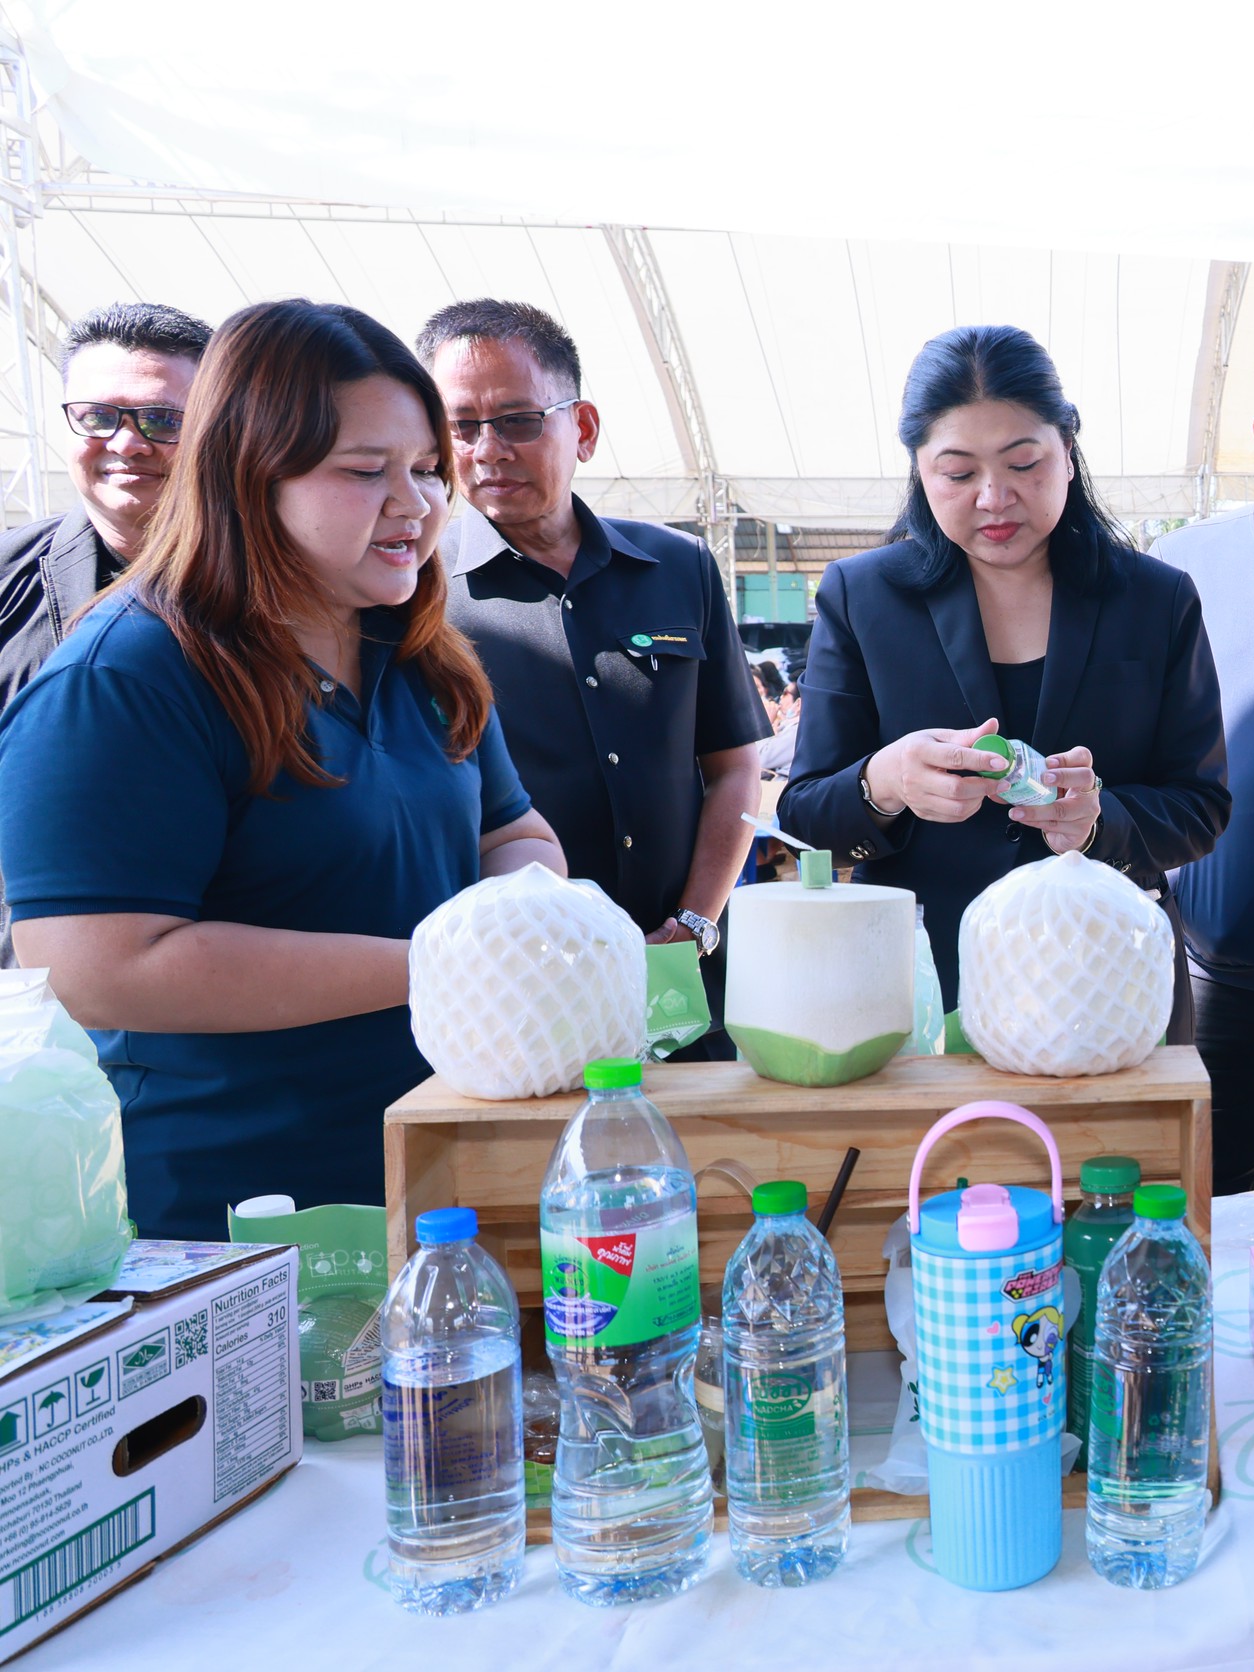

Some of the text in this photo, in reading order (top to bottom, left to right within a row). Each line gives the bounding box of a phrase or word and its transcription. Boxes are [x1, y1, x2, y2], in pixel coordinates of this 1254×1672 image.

[215, 1285, 260, 1314] Nutrition
[261, 1271, 287, 1291] Facts
[215, 1305, 286, 1355] Calories 310
[24, 1450, 31, 1462] &
[34, 1428, 71, 1456] HACCP
[74, 1406, 116, 1438] Certified
[51, 1440, 86, 1467] COCONUT
[54, 1480, 83, 1503] Thailand
